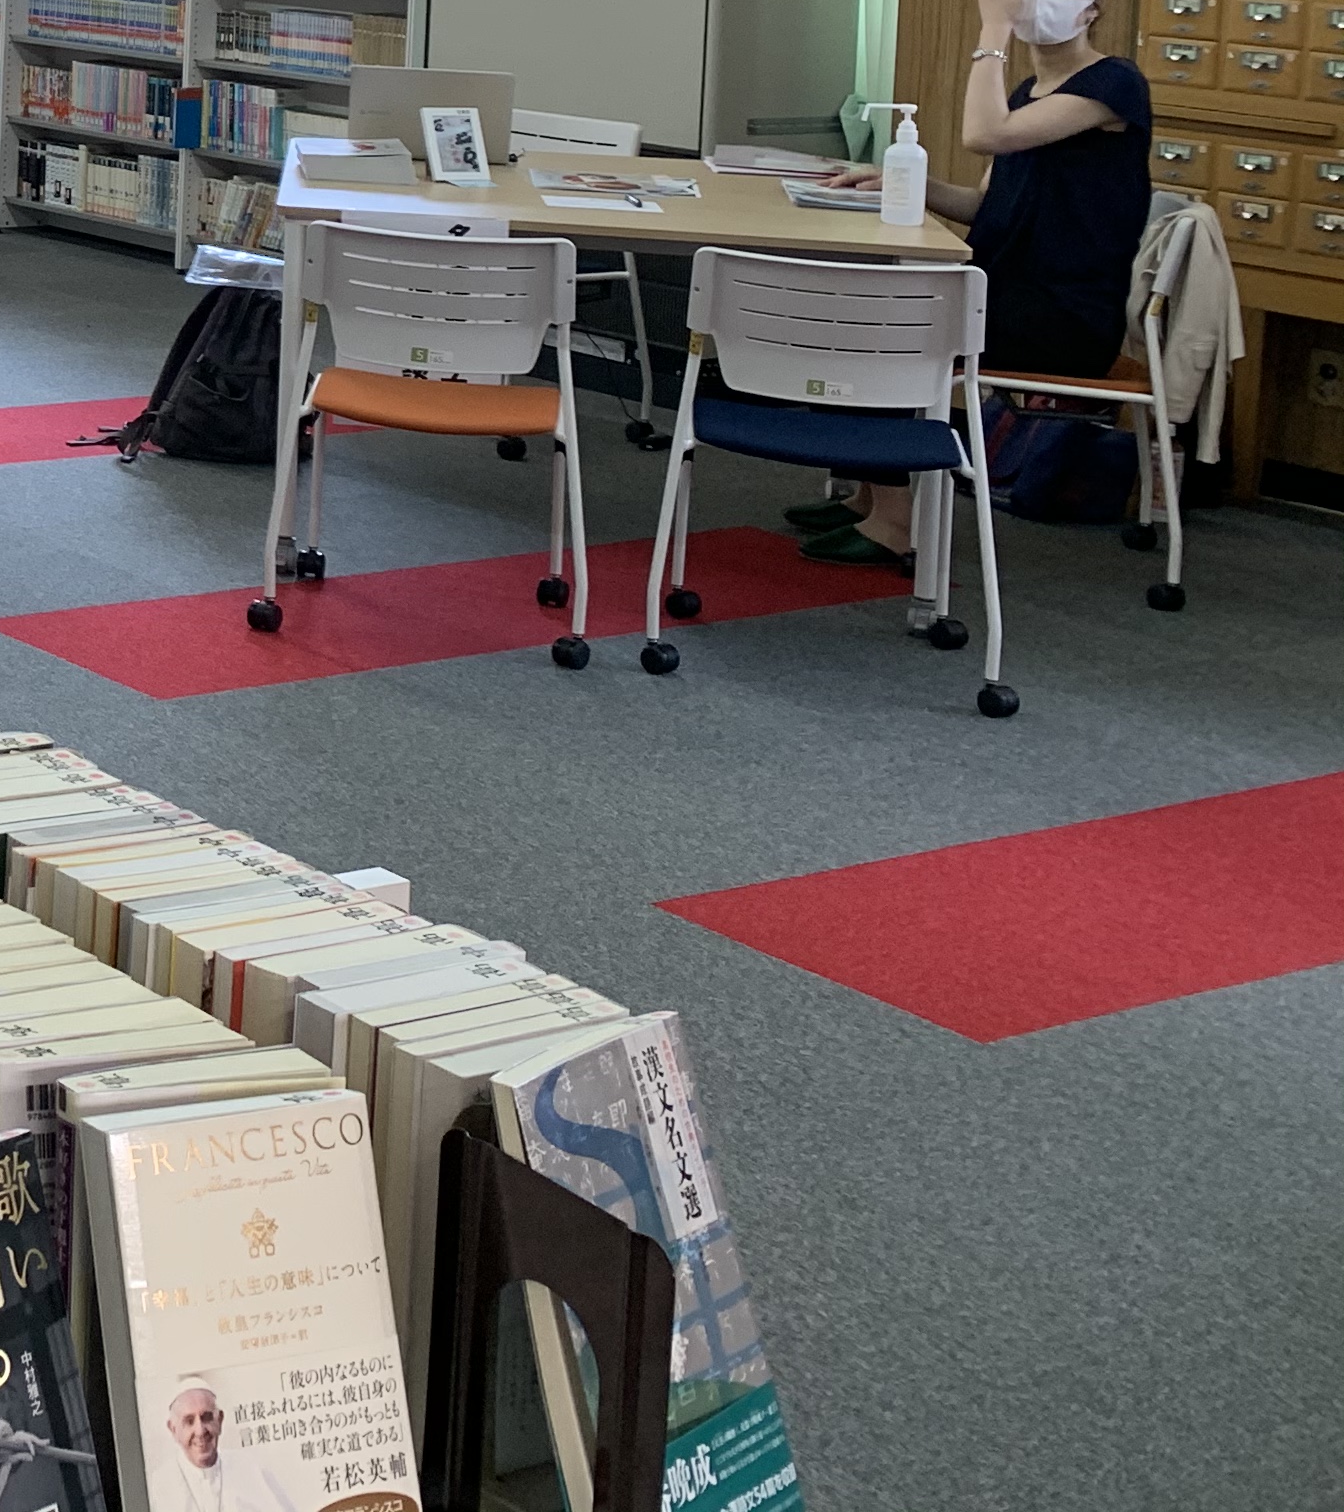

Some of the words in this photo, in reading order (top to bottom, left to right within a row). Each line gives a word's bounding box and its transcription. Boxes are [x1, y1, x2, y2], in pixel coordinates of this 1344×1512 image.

[127, 1112, 364, 1181] FRANCESCO
[641, 1045, 703, 1222] 漢文名文選
[20, 1350, 44, 1417] 中村雅之
[280, 1354, 394, 1392] 「彼の内なるものに
[233, 1377, 398, 1425] 直接ふれるには、彼自身の
[239, 1400, 401, 1448] 言葉と向き合うのがもっとも
[299, 1424, 405, 1462] 確実な道である」
[321, 1451, 408, 1494] 若松英輔
[662, 1443, 718, 1512] 晩成
